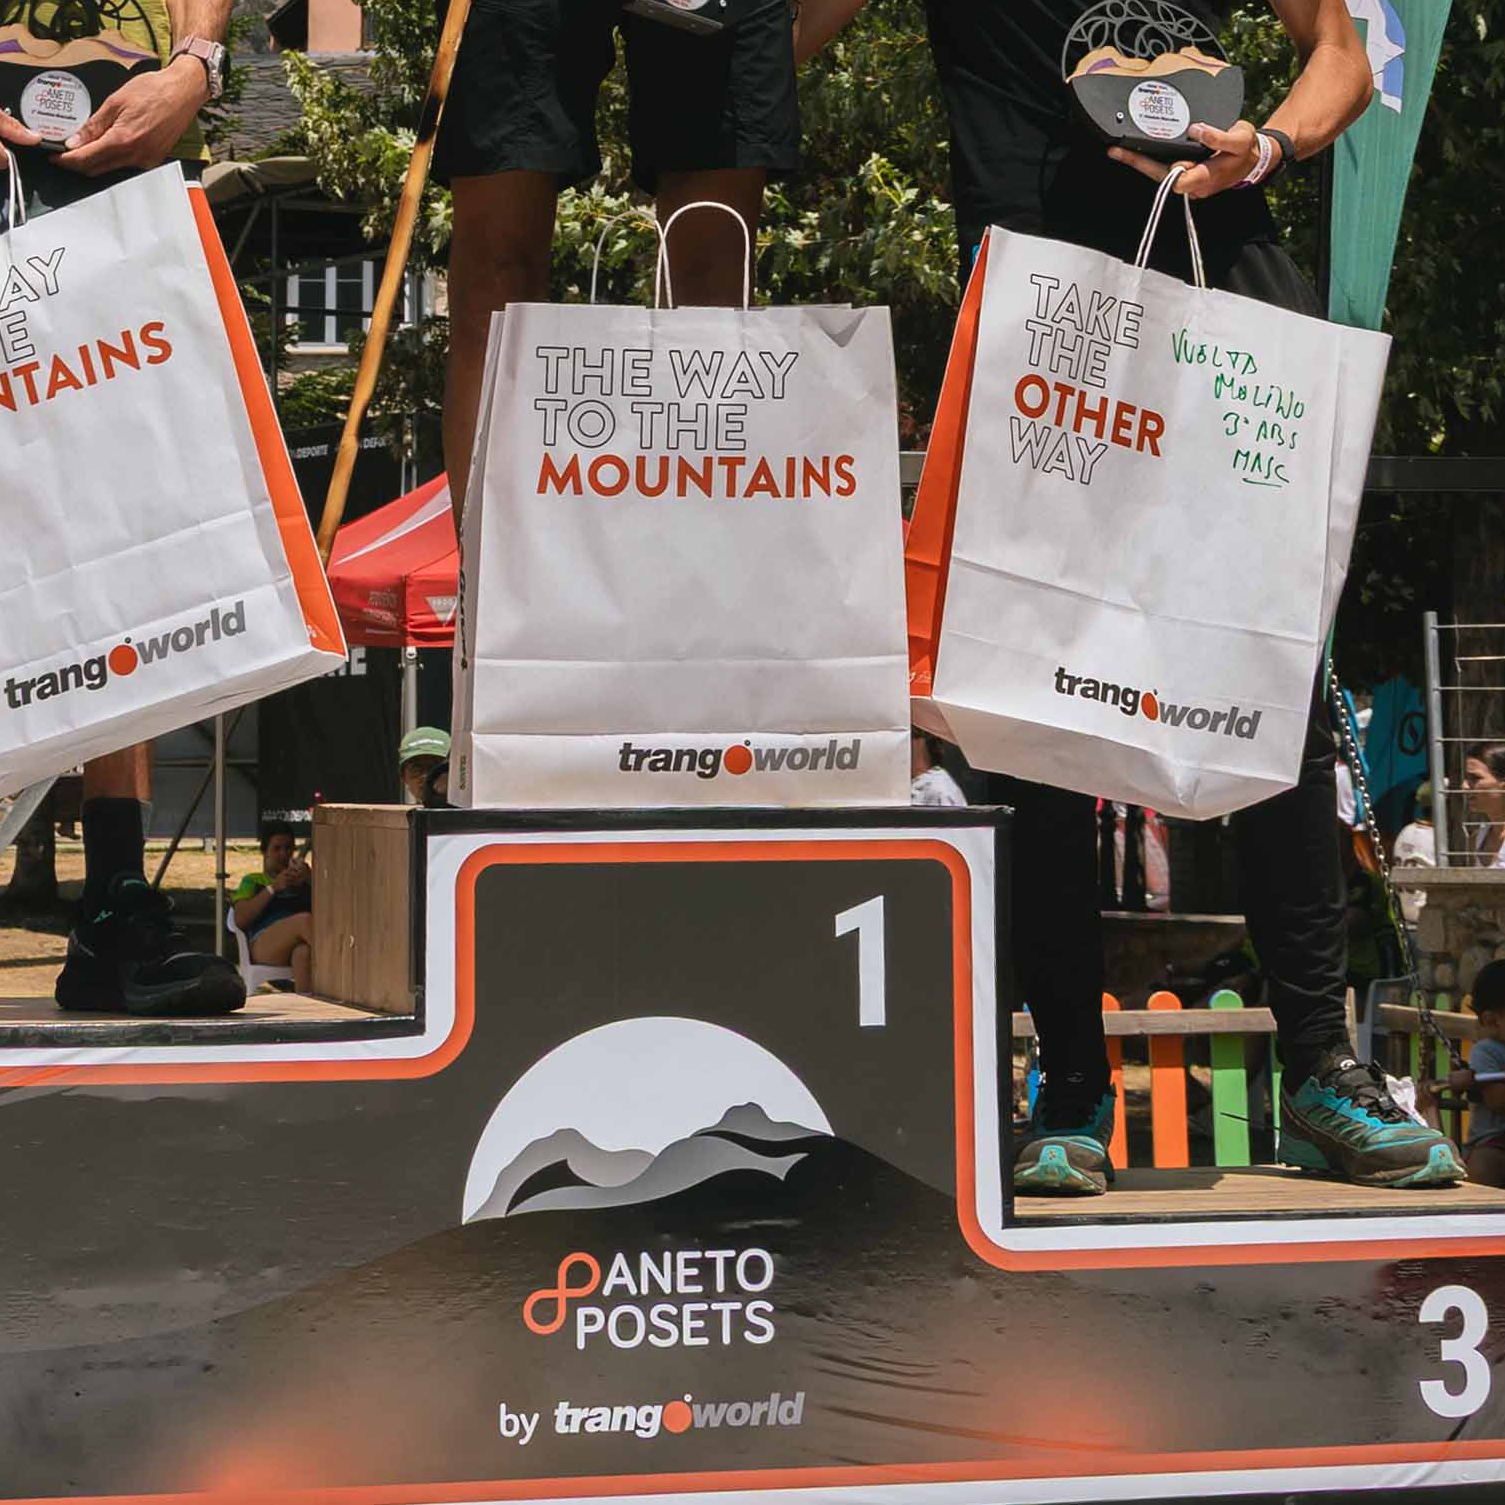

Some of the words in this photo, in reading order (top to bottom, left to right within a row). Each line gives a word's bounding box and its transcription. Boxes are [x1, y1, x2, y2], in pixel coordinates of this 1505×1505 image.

[1029, 273, 1144, 349] TAKE
[536, 346, 653, 397] THE
[669, 350, 799, 399] WAY
[1025, 320, 1111, 389] THE
[534, 398, 616, 448] TO
[631, 401, 747, 450] THE
[1013, 373, 1166, 457] OTHER
[293, 444, 329, 459] DEPORTE
[536, 453, 857, 498] MOUNTAINS
[1009, 416, 1108, 485] WAY
[1232, 448, 1290, 484] MASC
[834, 895, 885, 1028] 1
[601, 1247, 775, 1297] ANETO
[577, 1299, 776, 1351] POSETS
[1418, 1284, 1491, 1419] 3
[499, 1402, 540, 1446] by
